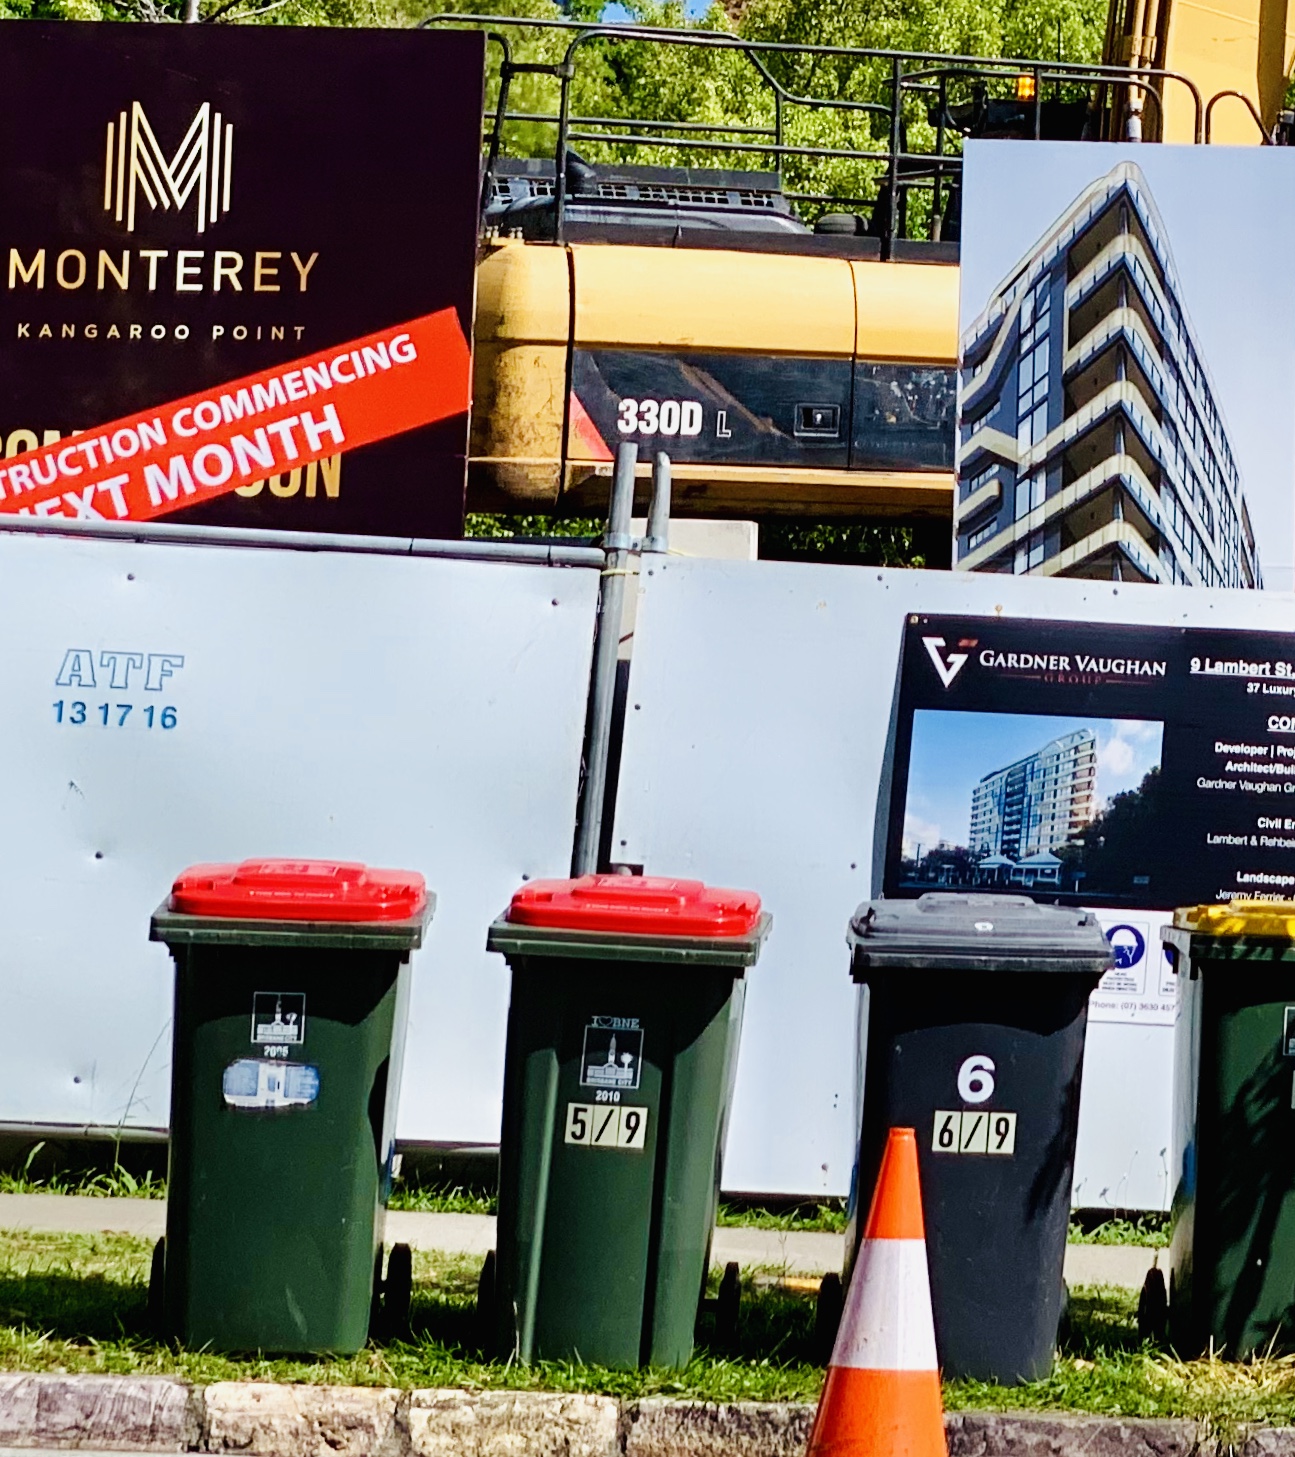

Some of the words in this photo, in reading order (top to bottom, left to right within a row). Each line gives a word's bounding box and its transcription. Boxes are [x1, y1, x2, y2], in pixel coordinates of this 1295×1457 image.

[8, 249, 319, 292] MONTEREY
[17, 323, 190, 340] KANGAROO
[211, 325, 306, 341] POINT
[172, 334, 418, 437] COMMENCING
[617, 398, 703, 436] 330D
[716, 410, 732, 438] L
[18, 473, 130, 520] EXT
[143, 403, 345, 507] MONTH
[55, 649, 185, 691] ATF
[978, 650, 1071, 671] GARDNER
[1075, 655, 1167, 676] VAUGHAN
[1190, 657, 1201, 671] 9
[1205, 658, 1271, 676] Lambert
[1246, 682, 1260, 694] 37
[52, 699, 87, 725] 13
[98, 702, 133, 727] 17
[143, 704, 178, 730] 16
[1215, 742, 1268, 757] Developer
[1196, 777, 1237, 791] Gardner
[1239, 780, 1282, 795] Vaughan
[1257, 817, 1282, 829] Civil
[1207, 833, 1248, 845] Lambert
[1236, 871, 1295, 887] Landscape
[957, 1054, 996, 1104] 6
[595, 1089, 621, 1103] 2010
[570, 1106, 641, 1144] 5/9
[938, 1114, 1010, 1150] 6/9
